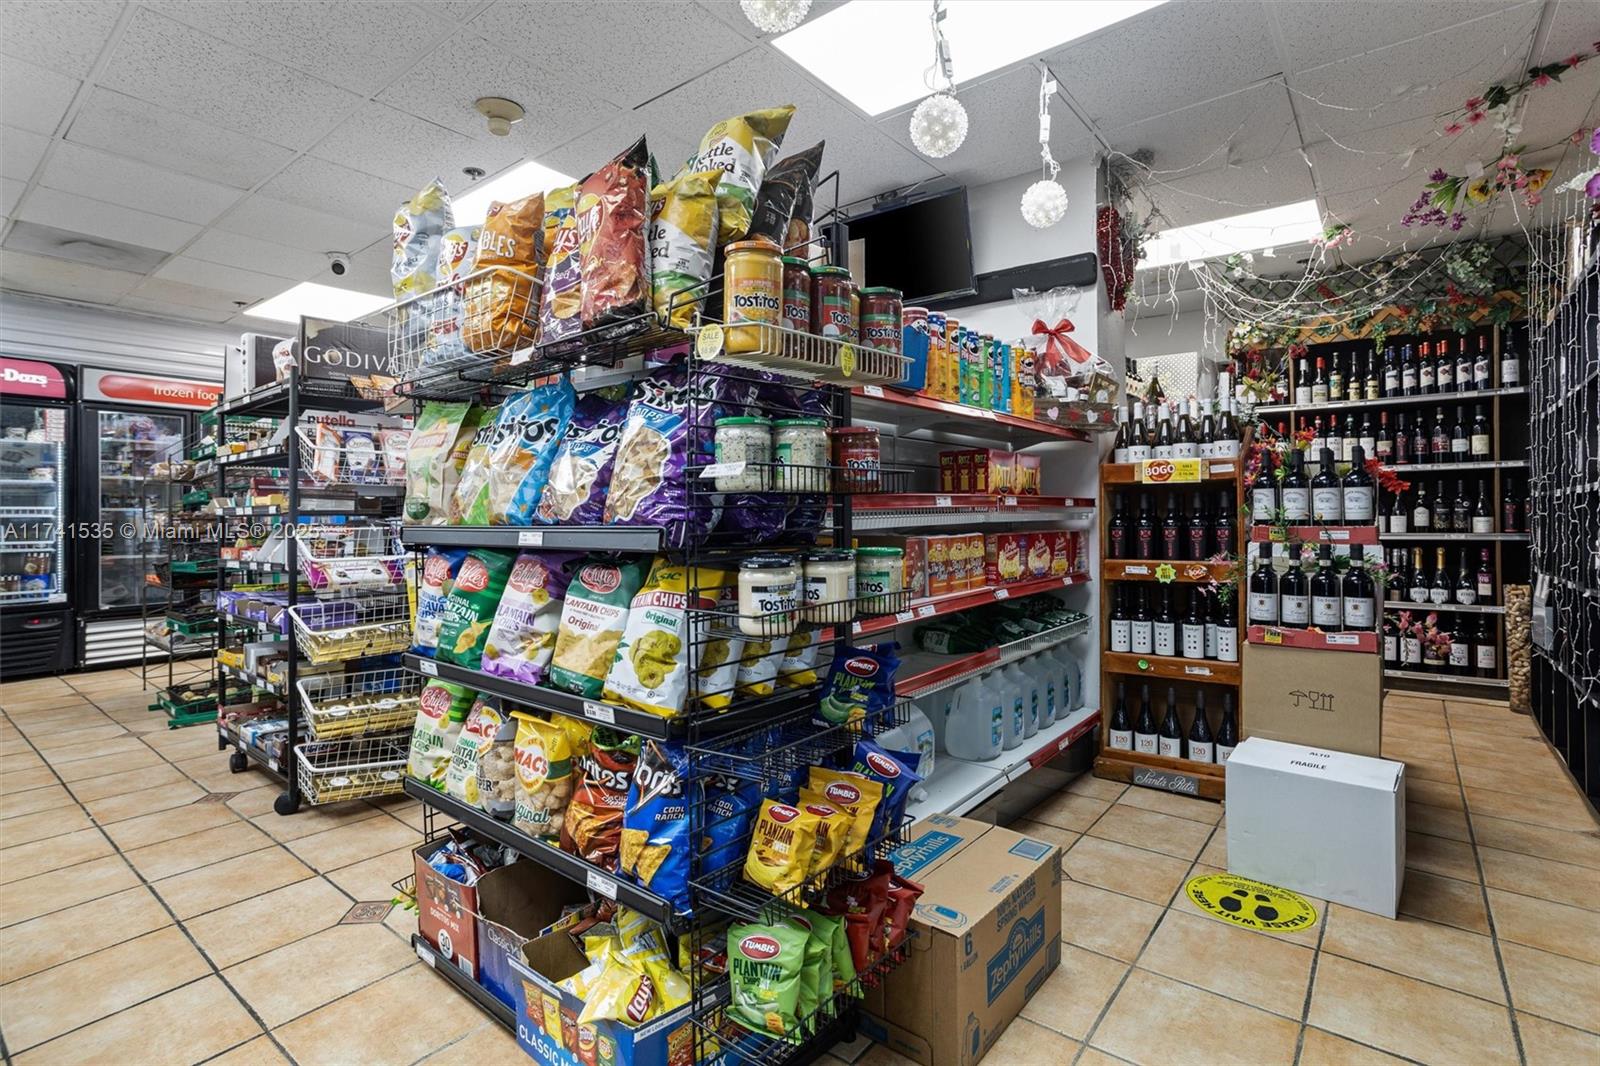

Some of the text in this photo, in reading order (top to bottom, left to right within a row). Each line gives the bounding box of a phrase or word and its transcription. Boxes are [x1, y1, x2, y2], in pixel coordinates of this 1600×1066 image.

[702, 332, 719, 341] SALE
[307, 414, 356, 427] nutella
[1144, 463, 1175, 476] BOGO
[565, 597, 600, 613] LANTAIN
[653, 592, 687, 609] CHIPS
[758, 597, 797, 612] TOSTiTO
[498, 604, 537, 627] LANTAIN
[645, 609, 678, 627] Original
[1115, 735, 1128, 744] 120
[1140, 739, 1154, 748] 120
[1192, 746, 1206, 756] 120
[1222, 751, 1231, 760] 12
[1309, 751, 1330, 759] ALTO
[514, 747, 548, 776] MAC'S
[1290, 759, 1327, 770] FRAGILE
[1135, 768, 1196, 794] Santa Rita
[830, 787, 857, 800] TUMBIS
[655, 812, 685, 821] RANCH
[663, 806, 685, 814] COOL
[707, 805, 733, 818] RANCH
[758, 819, 795, 846] PLANTAIN
[894, 836, 949, 877] ephyrhills
[1192, 889, 1217, 910] HERE
[1215, 909, 1257, 927] WAIT
[1262, 914, 1309, 929] PLEASE
[745, 940, 776, 954] TUMBIS
[964, 932, 973, 957] 6
[733, 957, 783, 982] PLANTAIN
[518, 1024, 559, 1066] CLASSIC
